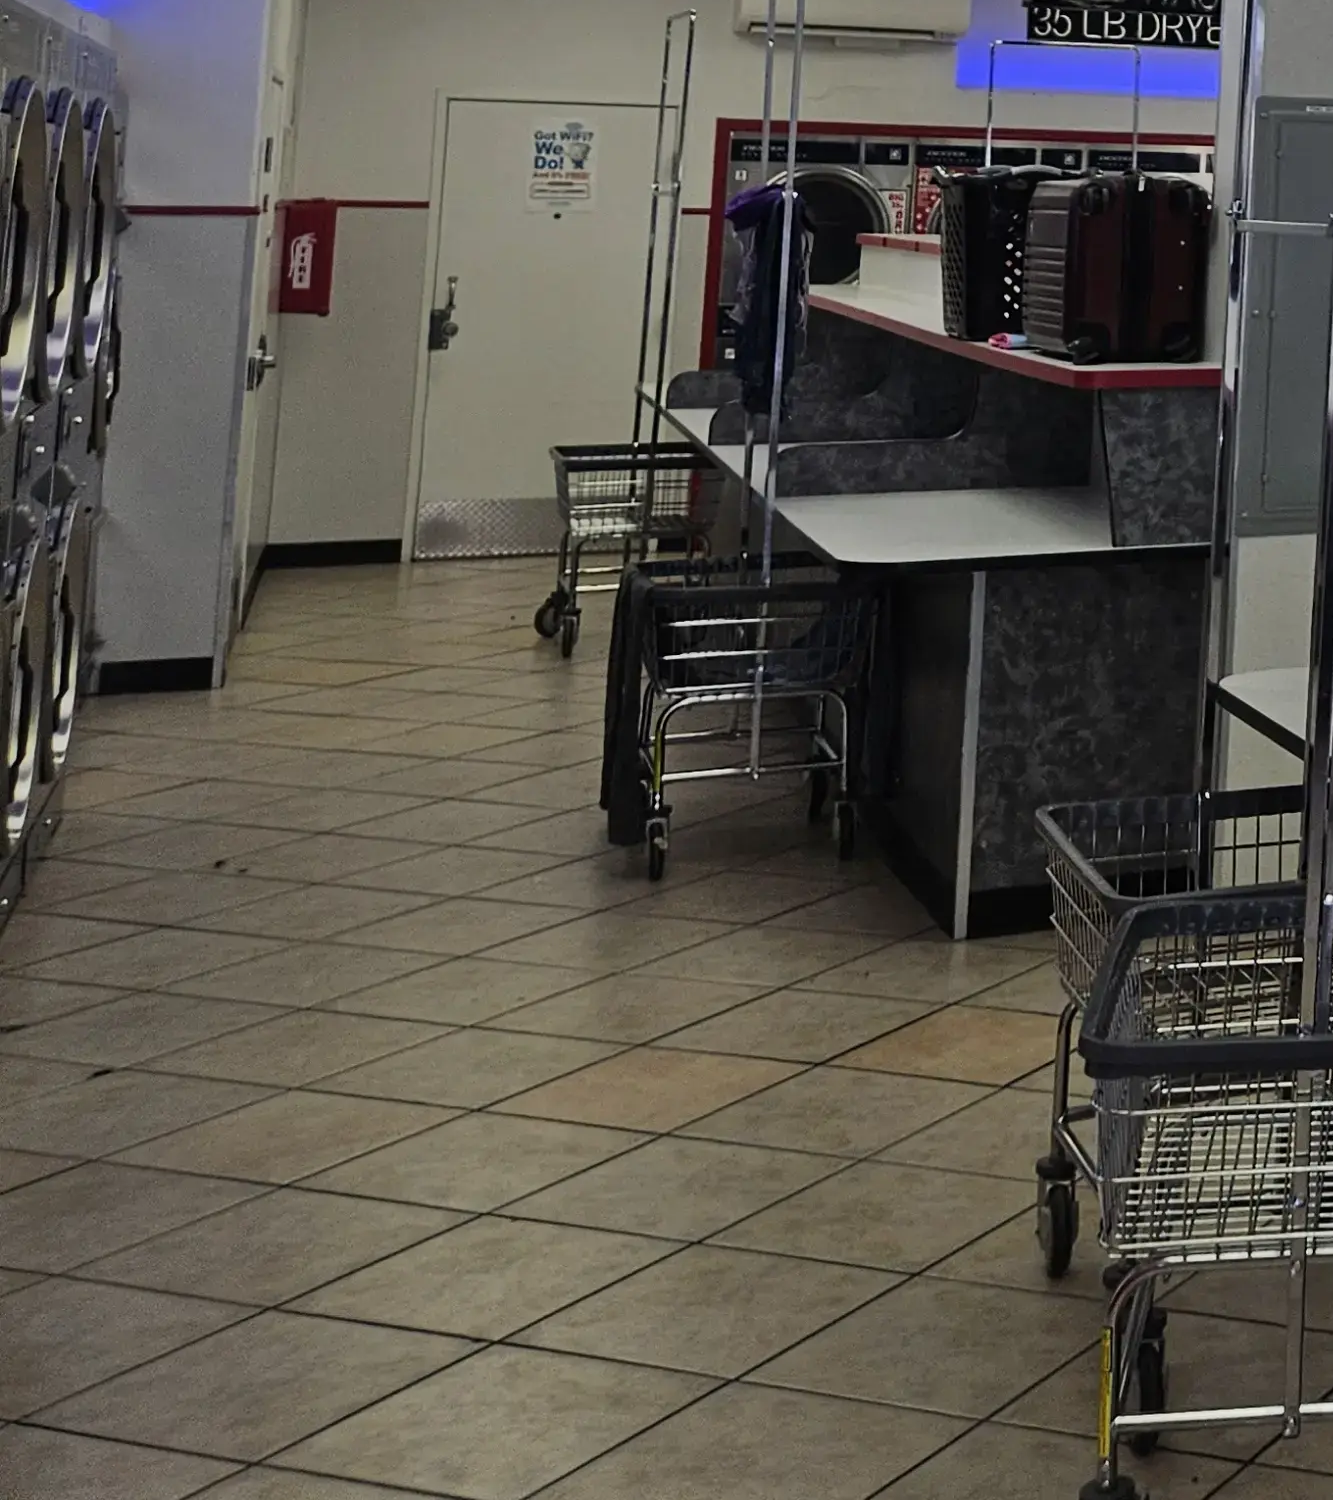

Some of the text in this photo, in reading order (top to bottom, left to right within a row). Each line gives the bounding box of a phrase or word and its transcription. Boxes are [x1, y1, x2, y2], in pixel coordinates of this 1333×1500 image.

[1033, 7, 1073, 37] 35
[1083, 9, 1126, 39] LB
[534, 130, 557, 141] Got
[535, 142, 564, 156] We
[534, 156, 564, 170] Do!
